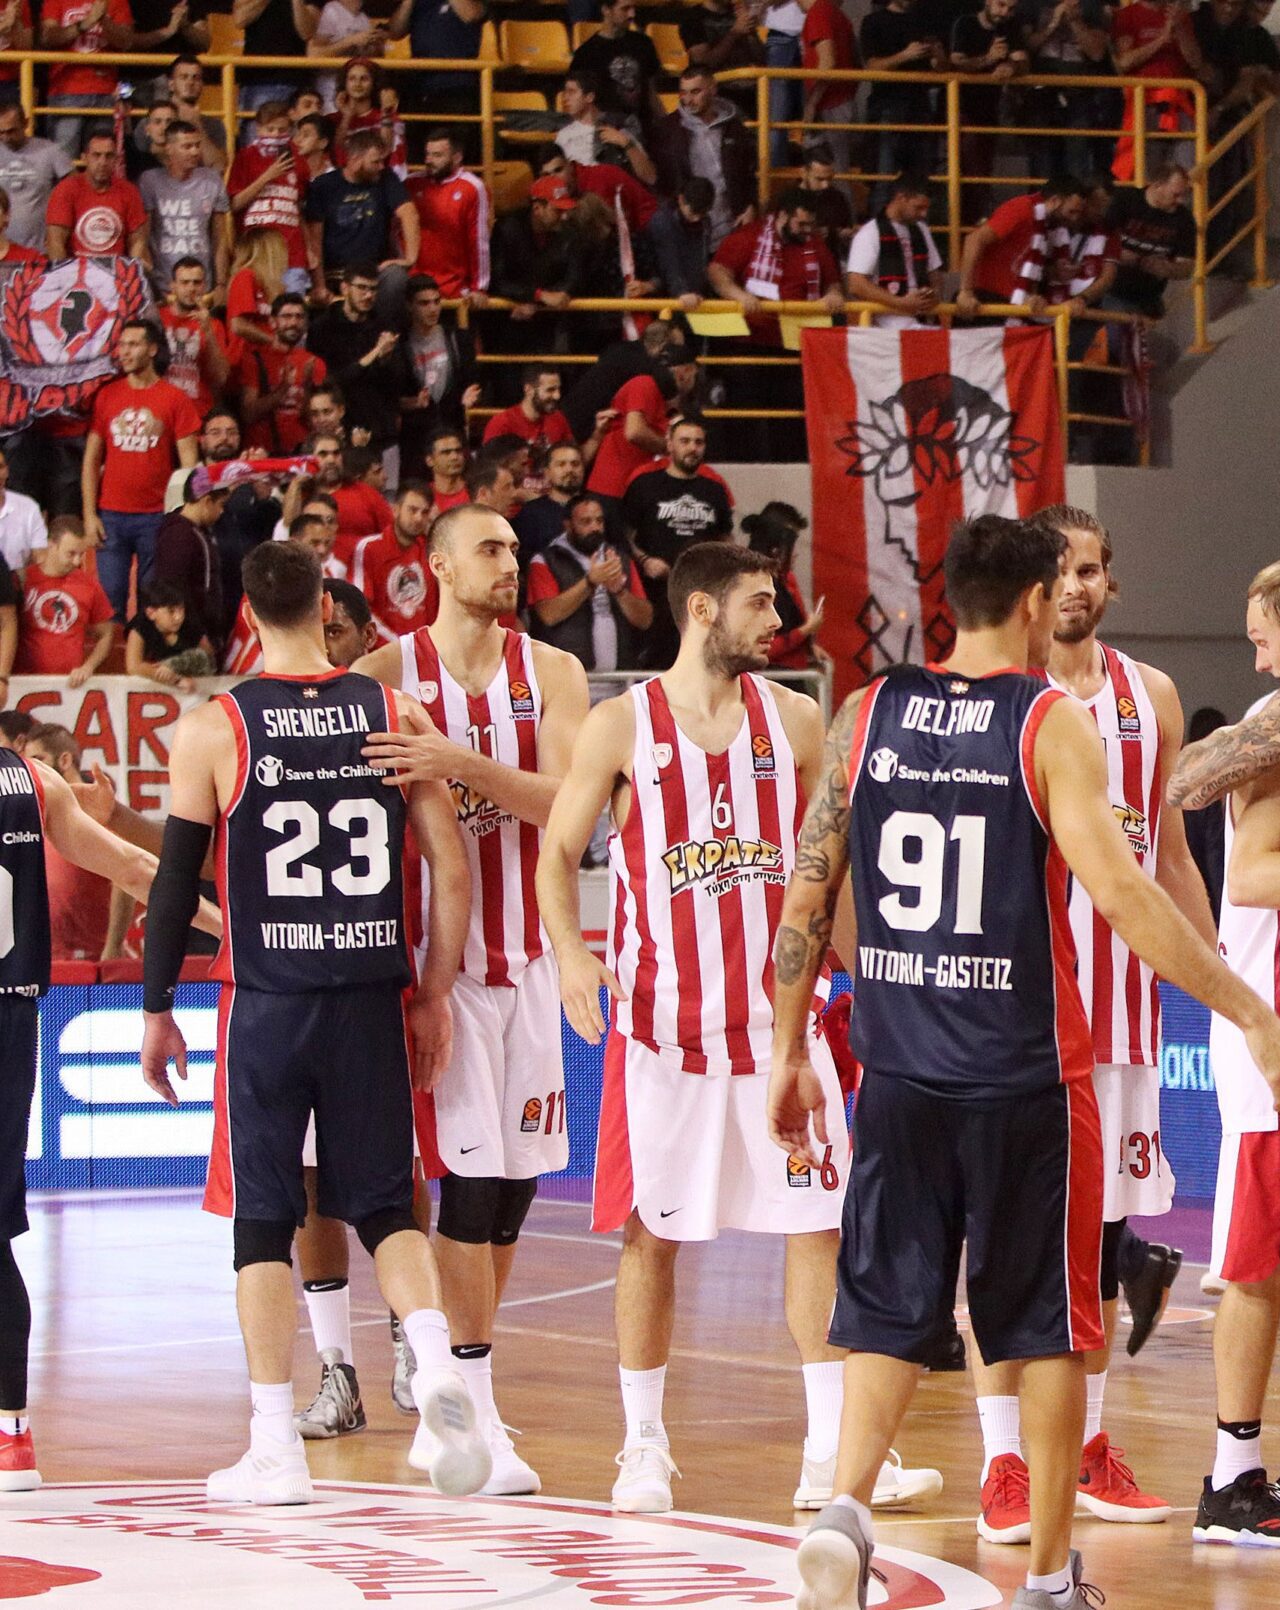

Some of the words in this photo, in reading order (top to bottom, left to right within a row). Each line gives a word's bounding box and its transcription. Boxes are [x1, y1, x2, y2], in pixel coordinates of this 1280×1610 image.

[158, 199, 192, 216] WE
[262, 704, 371, 738] SHENGELIA
[901, 695, 996, 737] DELFINO
[466, 723, 499, 762] 11
[285, 768, 314, 781] Save
[317, 768, 338, 780] the
[339, 765, 387, 779] Children
[897, 765, 930, 782] Save
[931, 768, 951, 783] the
[951, 767, 1009, 787] Children
[712, 781, 732, 829] 6
[262, 798, 391, 897] 23
[877, 810, 986, 935] 91
[260, 919, 397, 950] VITORIA-GASTEIZ
[859, 946, 1013, 991] VITORIA-GASTEIZ
[544, 1090, 565, 1135] 11
[820, 1145, 840, 1191] 6
[1128, 1131, 1161, 1179] 31
[8, 1513, 499, 1601] BASKETBALL
